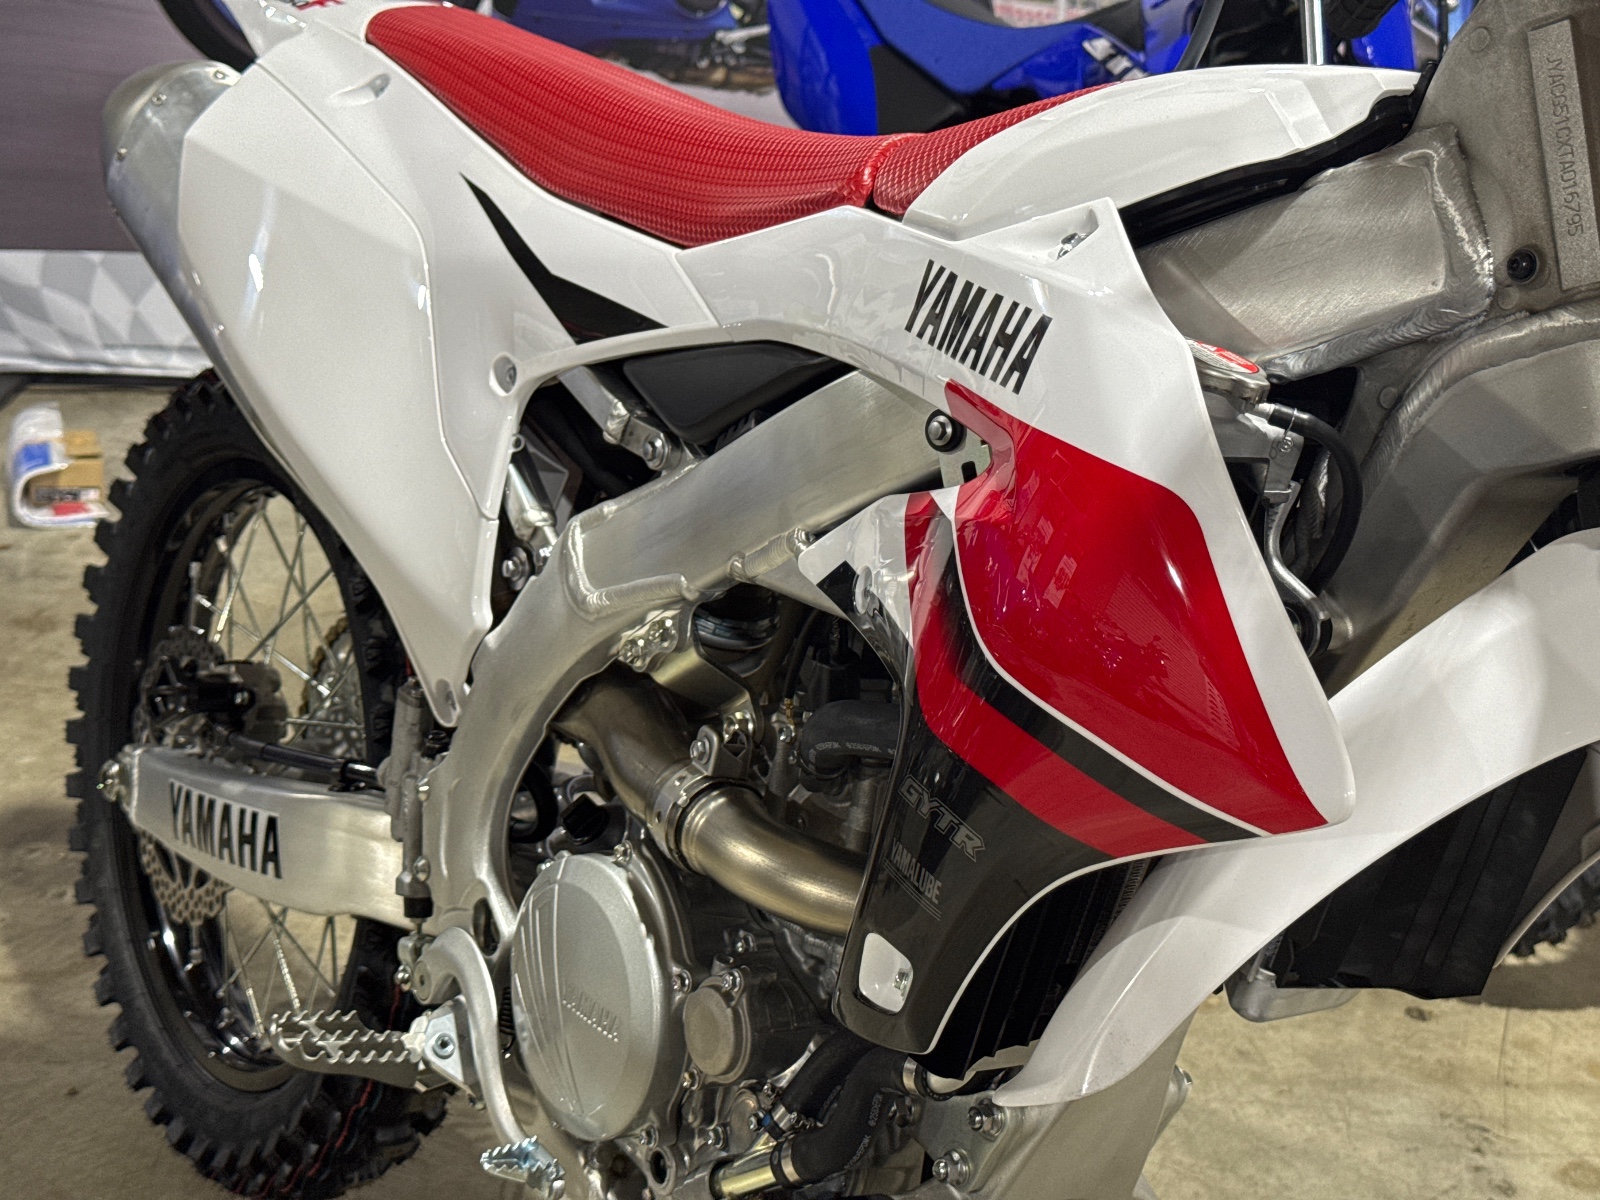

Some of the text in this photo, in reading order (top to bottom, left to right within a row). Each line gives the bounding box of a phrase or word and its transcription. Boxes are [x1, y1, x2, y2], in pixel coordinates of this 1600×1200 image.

[904, 258, 1054, 396] YAMAHA
[168, 780, 282, 880] YAMAHA
[898, 774, 985, 862] GYTR
[890, 837, 943, 905] YAMALUBE
